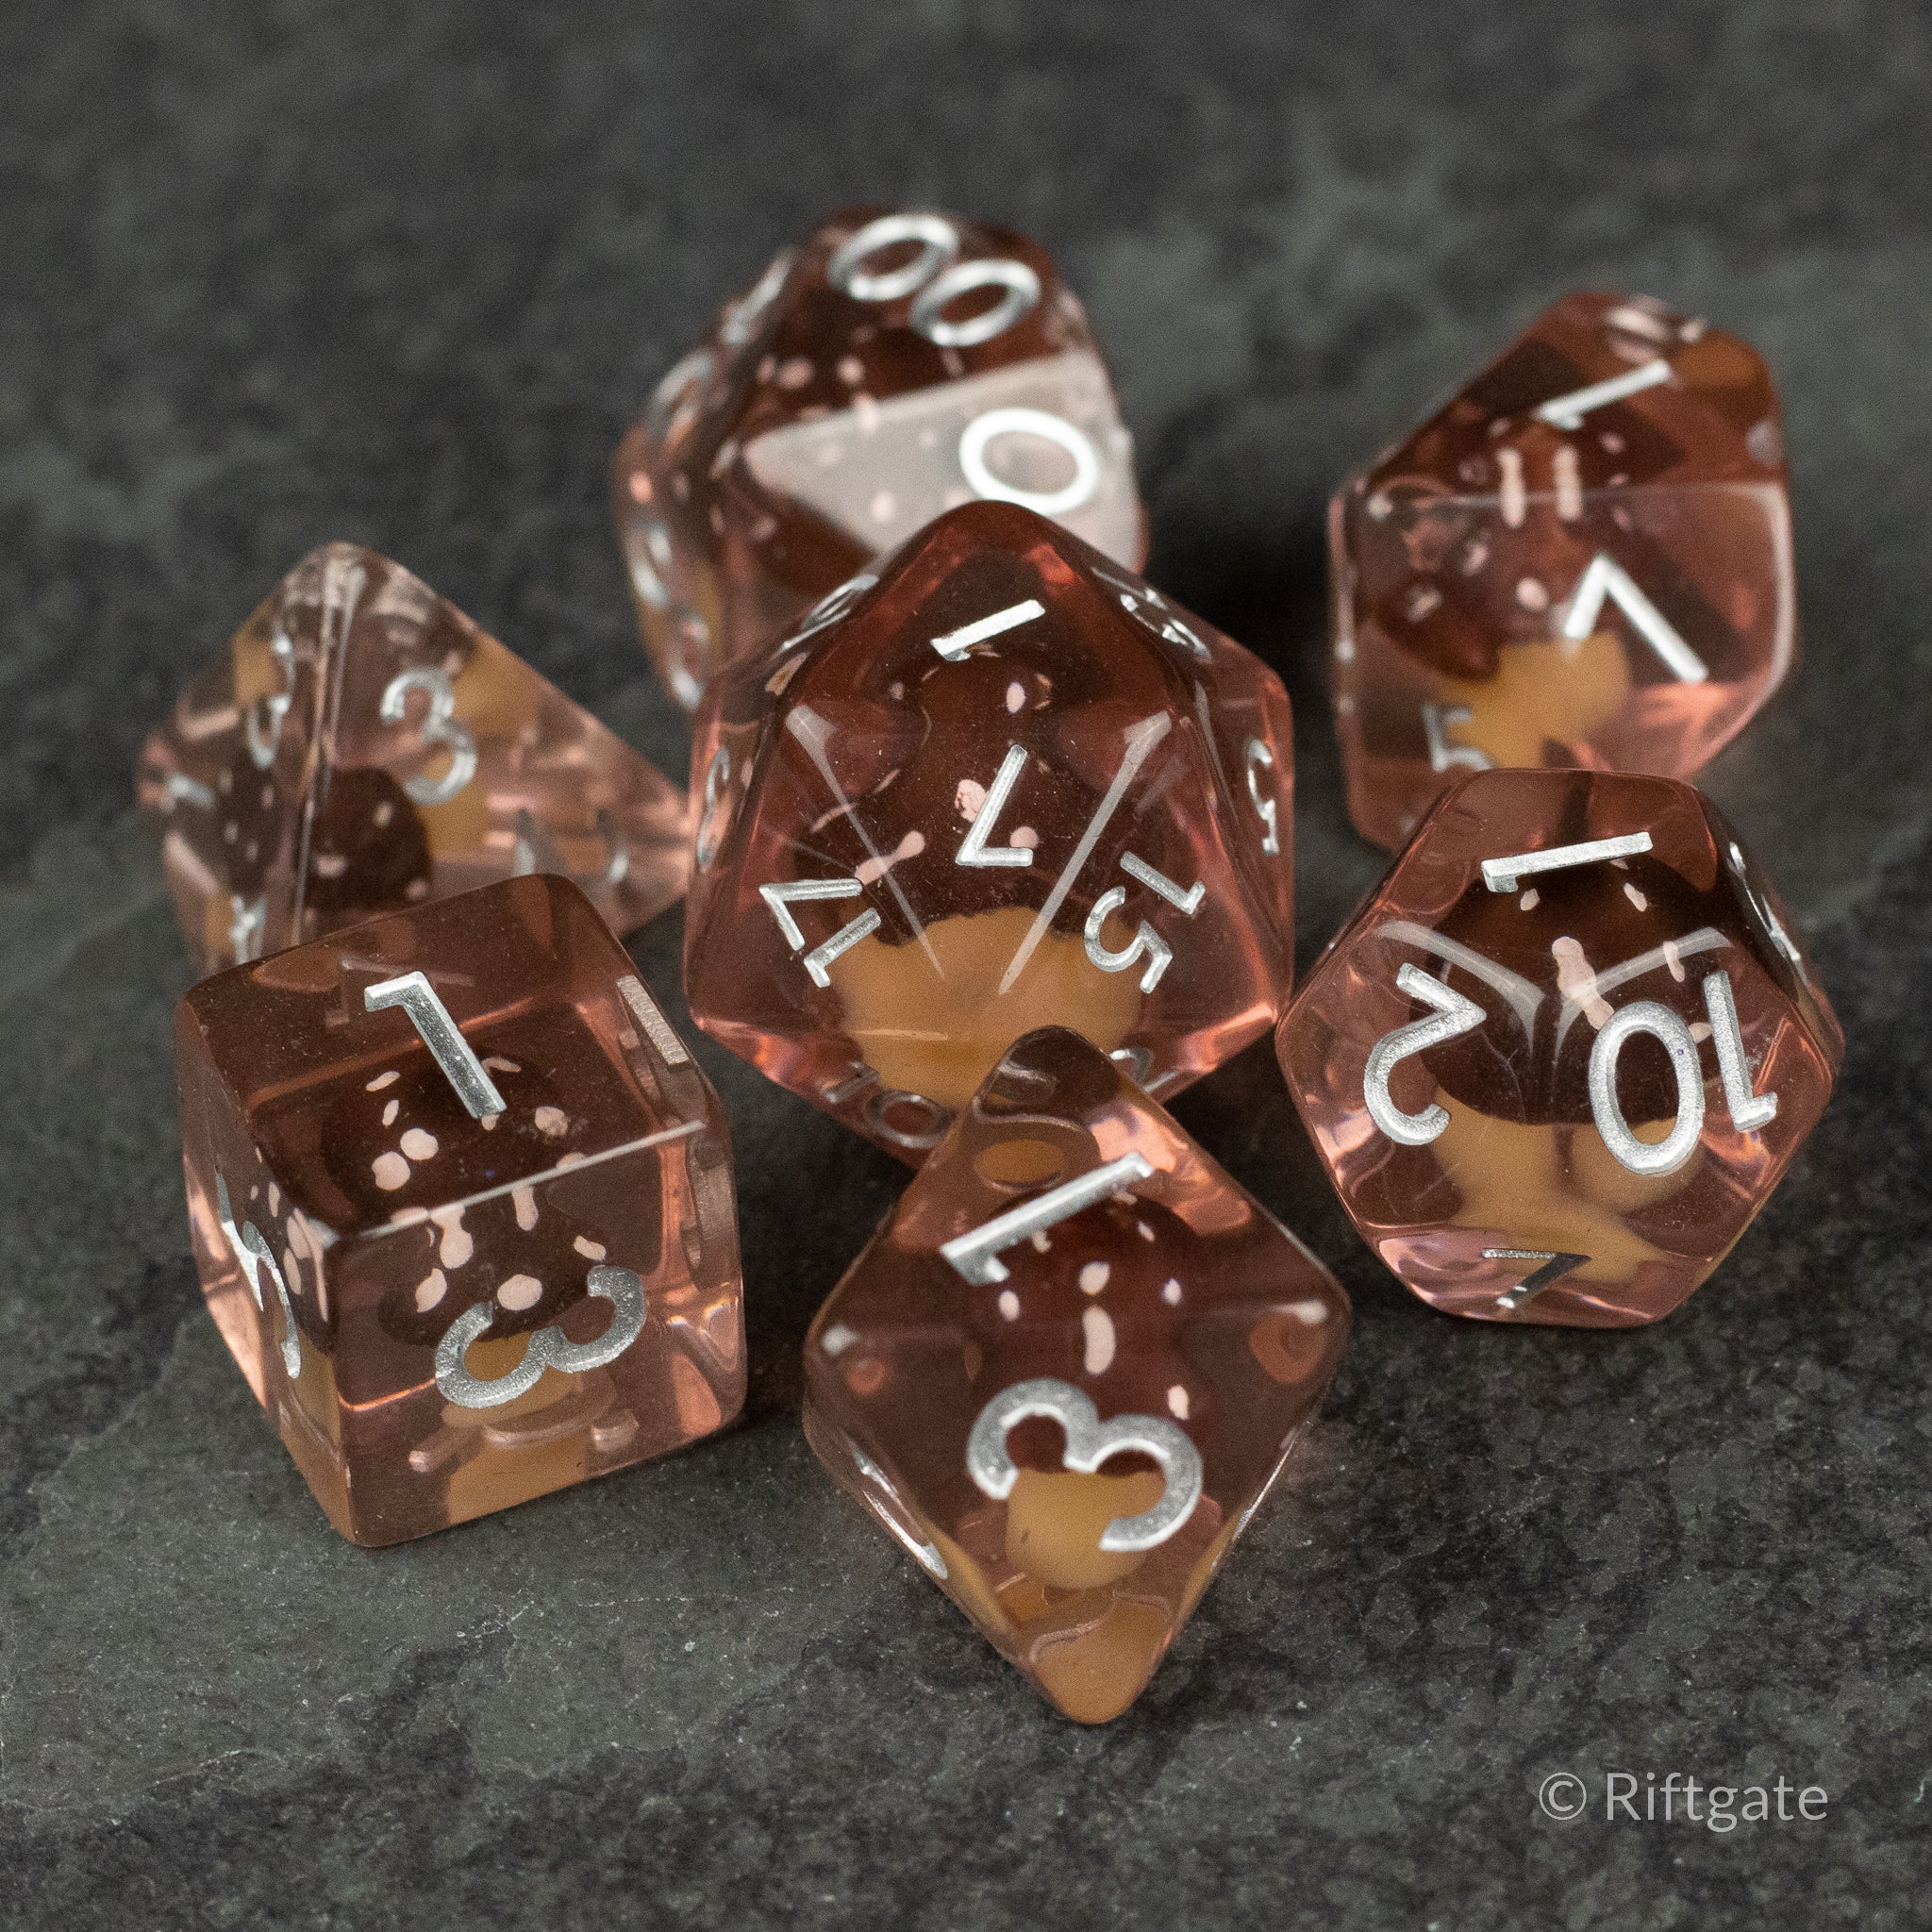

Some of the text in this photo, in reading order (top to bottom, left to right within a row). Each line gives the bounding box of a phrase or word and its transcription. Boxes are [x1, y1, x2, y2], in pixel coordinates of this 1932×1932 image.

[930, 599, 1045, 660] 1
[379, 667, 475, 805] 3
[955, 744, 1034, 867] 7
[1083, 850, 1207, 993] 15
[1481, 831, 1653, 892] 1
[364, 971, 508, 1118] 1
[1363, 962, 1487, 1145] 2
[1588, 971, 1777, 1175] 10
[940, 1152, 1154, 1285] 1
[435, 1265, 646, 1408] 3
[966, 1378, 1204, 1552] 3
